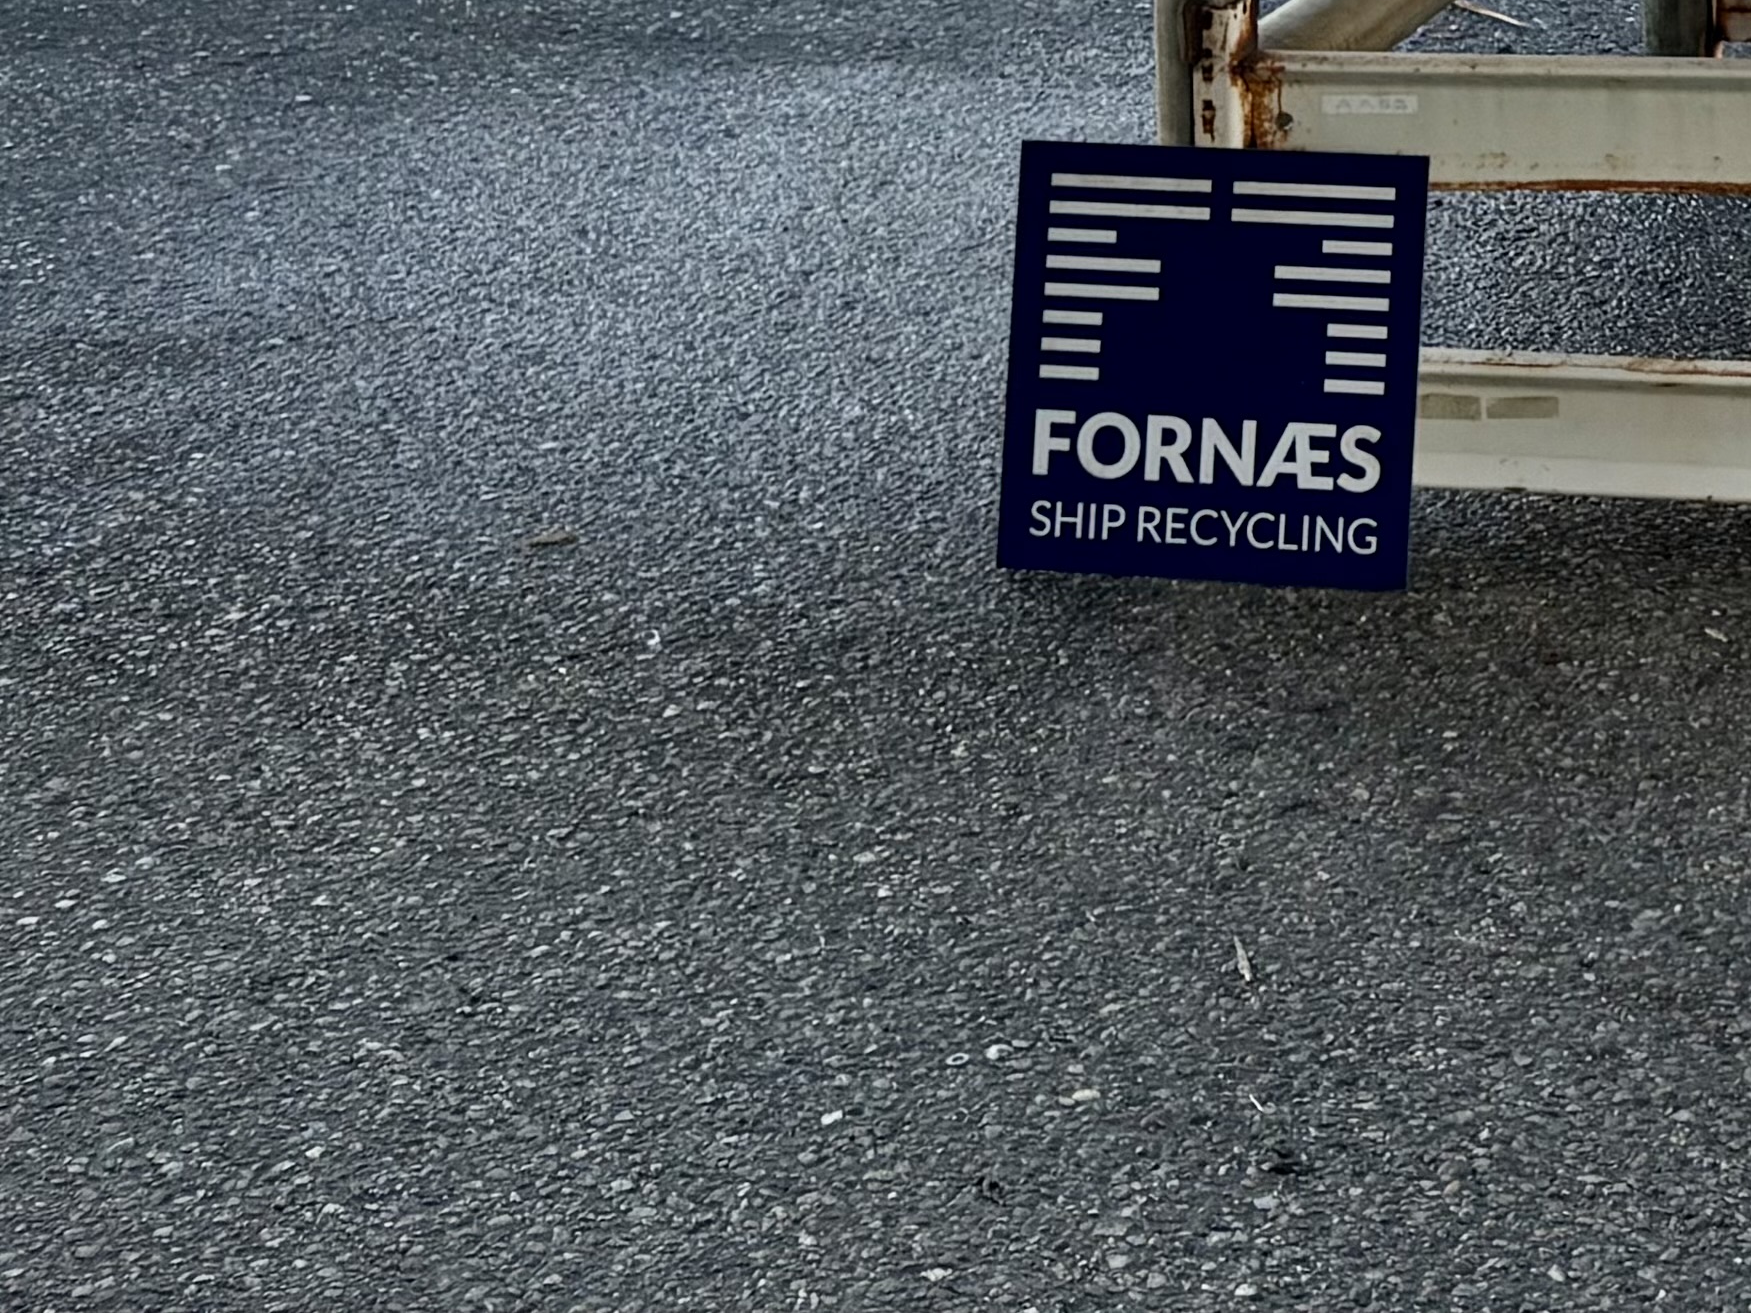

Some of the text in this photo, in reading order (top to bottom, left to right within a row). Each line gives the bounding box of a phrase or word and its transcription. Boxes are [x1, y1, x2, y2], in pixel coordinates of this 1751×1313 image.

[1032, 409, 1382, 493] FORNÆS
[1029, 500, 1378, 555] SHIP RECYCLING
